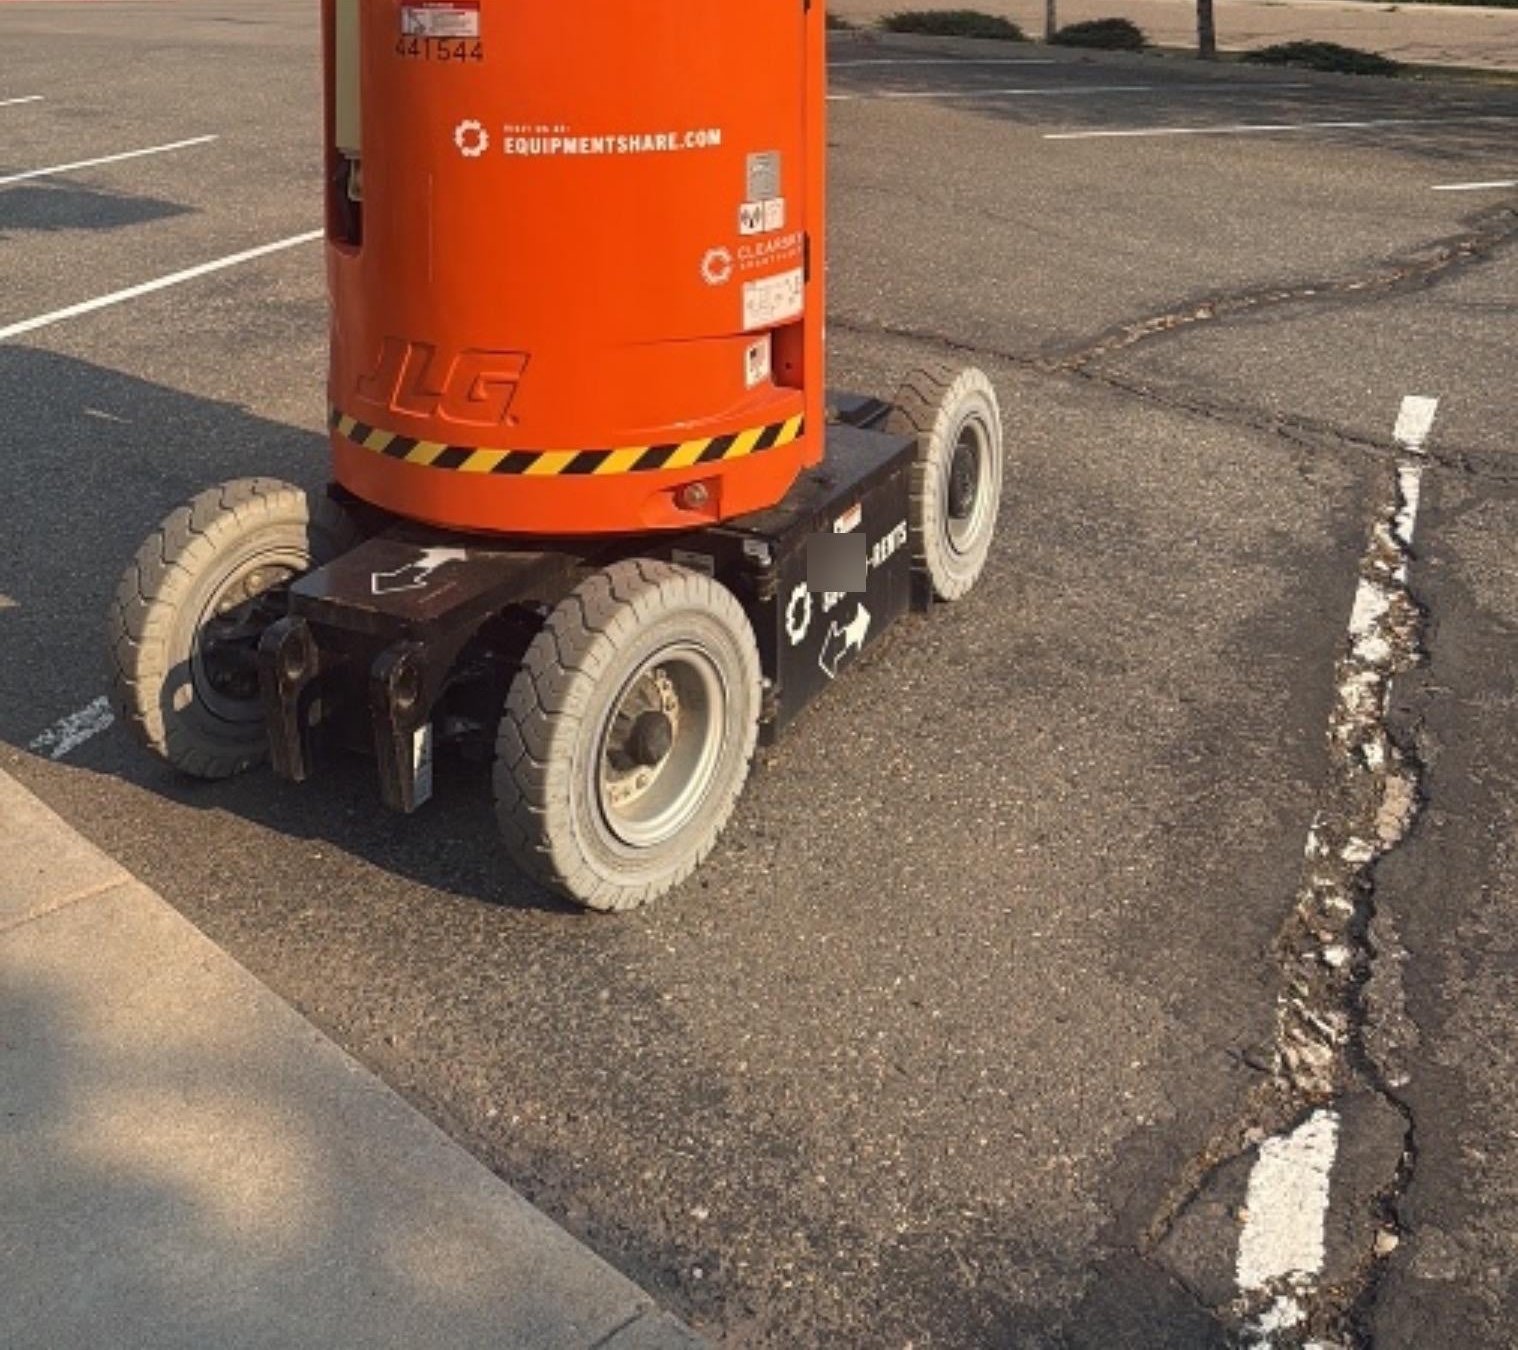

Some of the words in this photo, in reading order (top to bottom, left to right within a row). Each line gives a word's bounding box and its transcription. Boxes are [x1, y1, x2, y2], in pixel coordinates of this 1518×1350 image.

[395, 38, 483, 63] 441544
[503, 128, 722, 156] EQUIPMENTSHARE.COM
[355, 336, 531, 428] JLG
